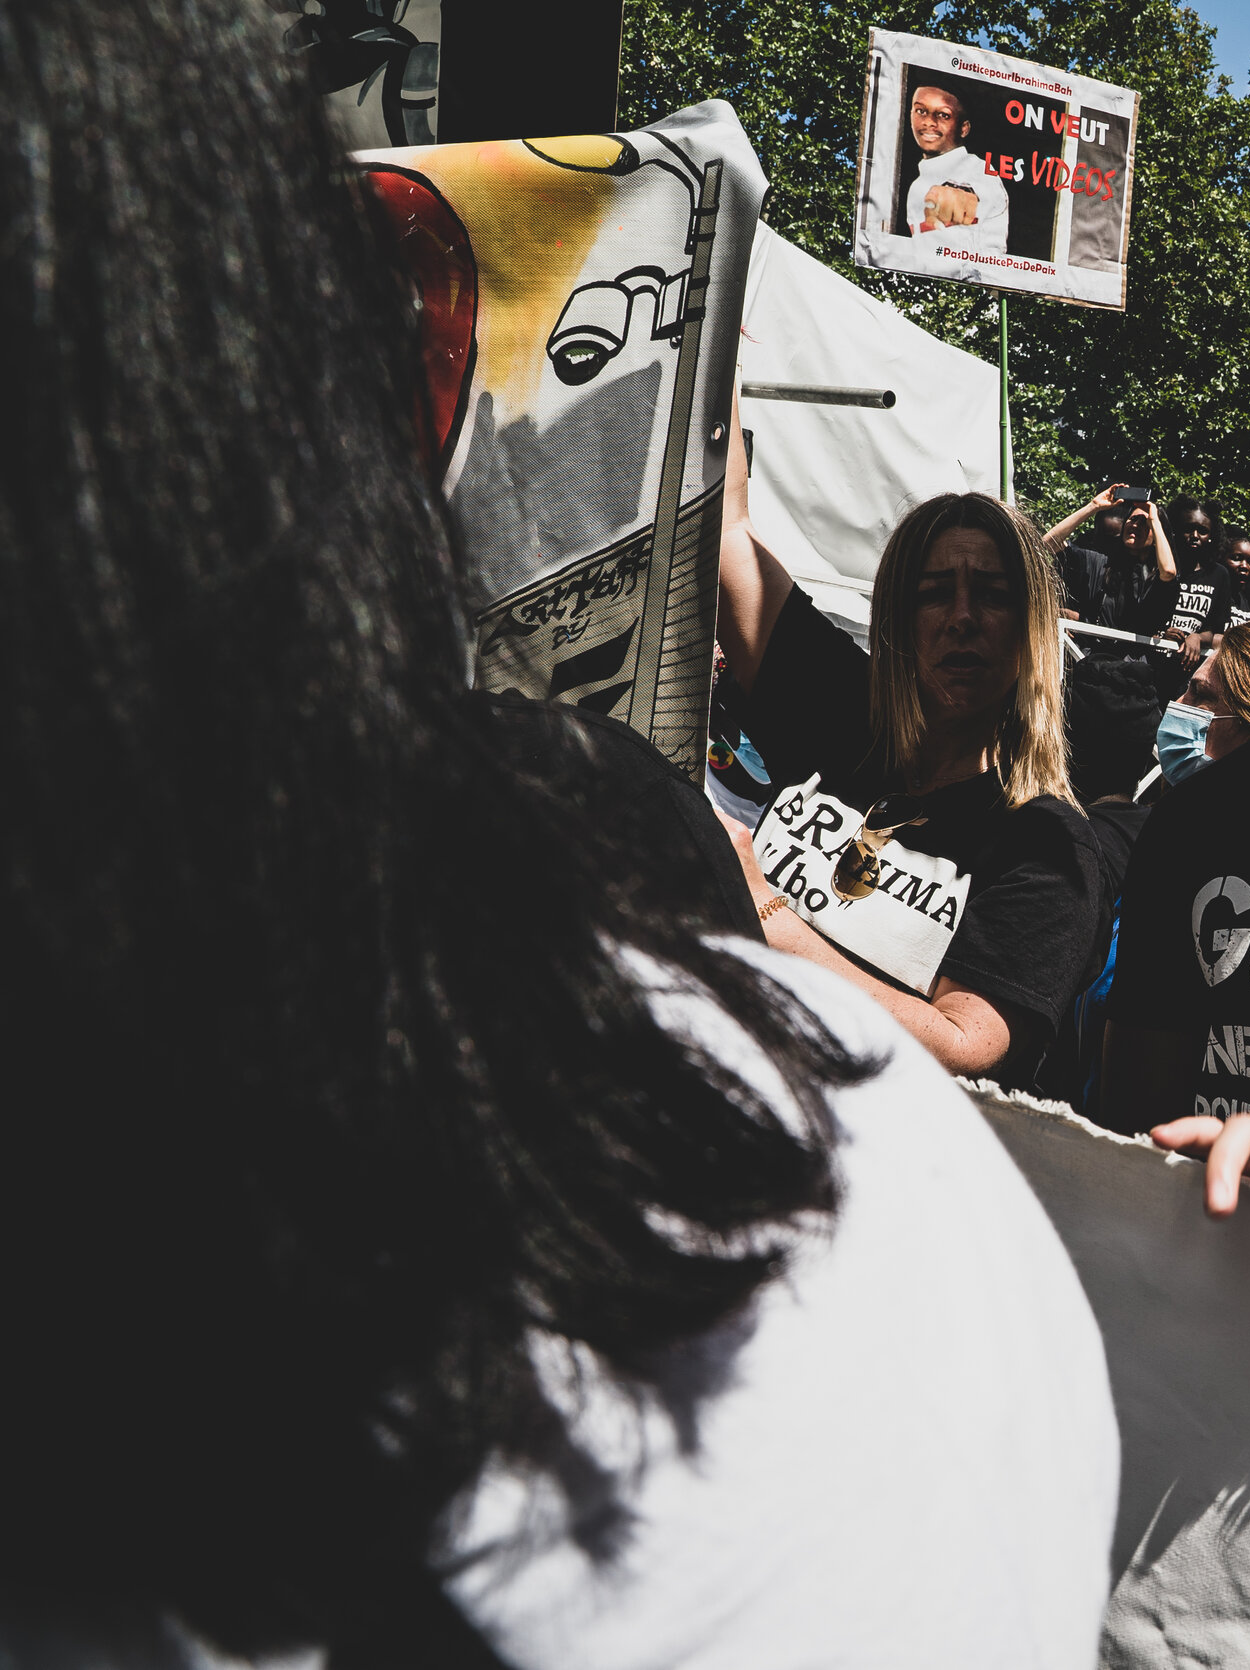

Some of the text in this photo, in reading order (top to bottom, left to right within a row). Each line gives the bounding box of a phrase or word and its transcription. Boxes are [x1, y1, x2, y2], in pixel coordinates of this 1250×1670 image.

[951, 57, 1073, 97] @justicepourIbrahimaBah
[1005, 99, 1110, 146] ON VEUT
[984, 151, 1025, 183] LES
[935, 246, 1057, 277] #PasDeJusticePasDePaix
[1190, 583, 1215, 595] pour
